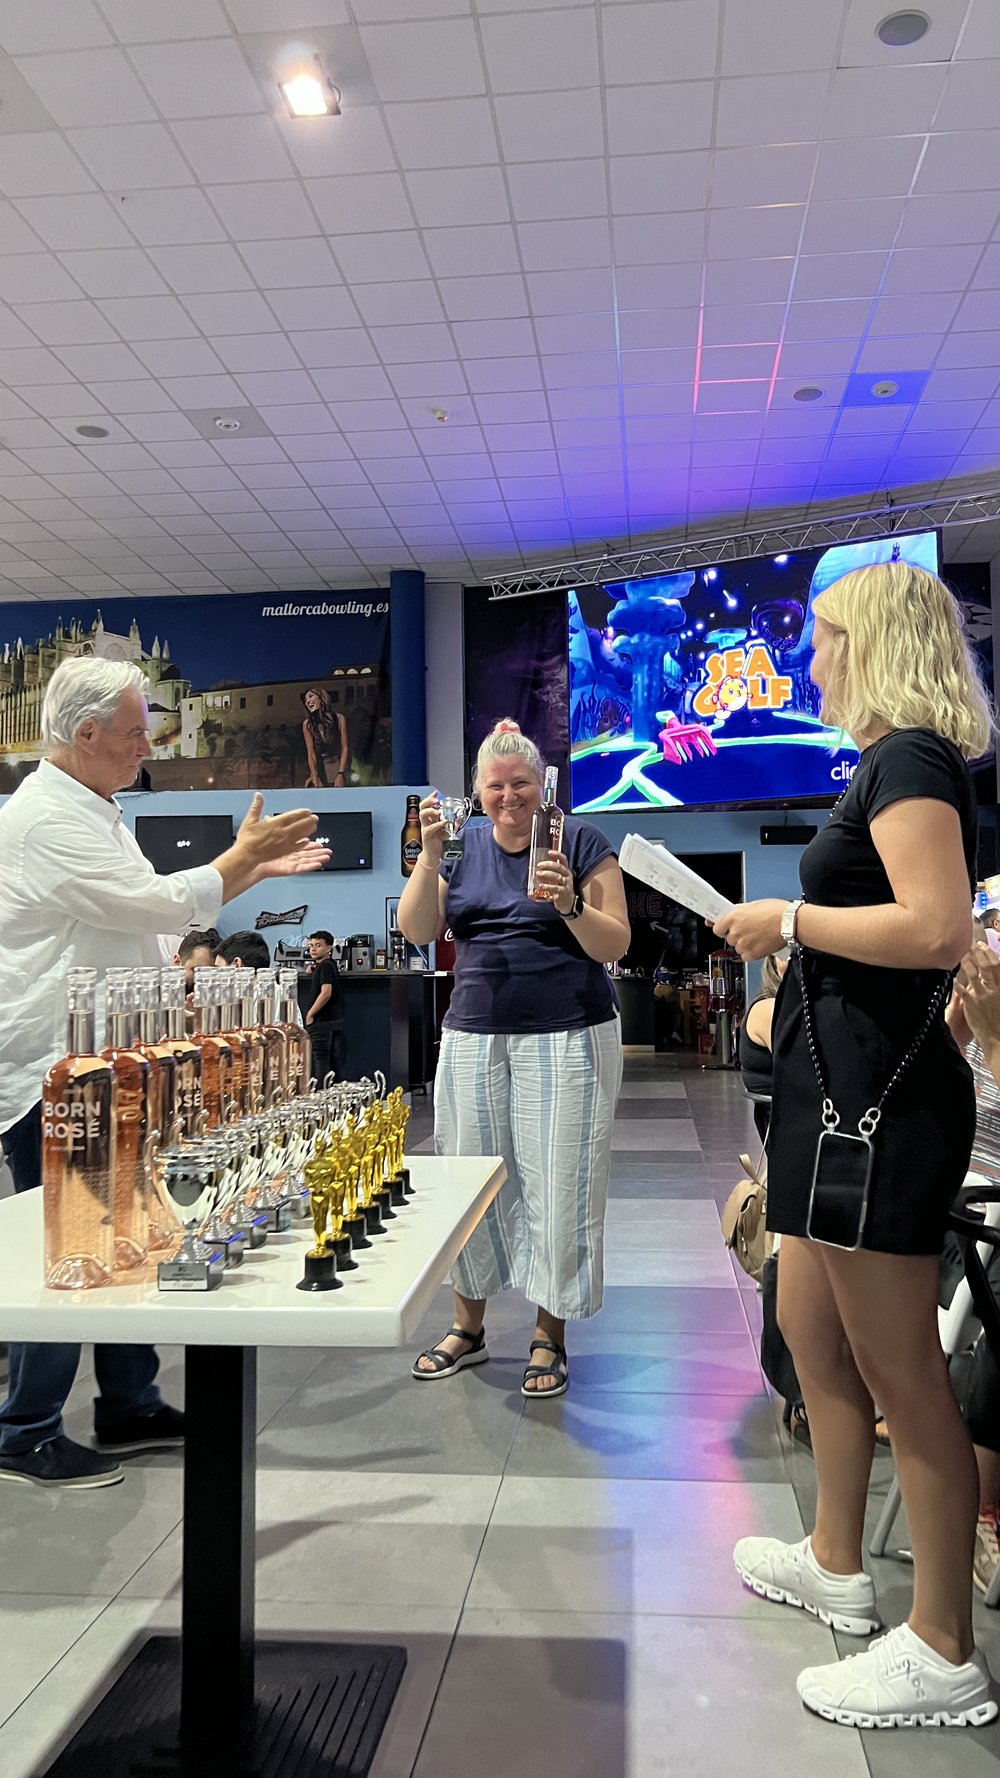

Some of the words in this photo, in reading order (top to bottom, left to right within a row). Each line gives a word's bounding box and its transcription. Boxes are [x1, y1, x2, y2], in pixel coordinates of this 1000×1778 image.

[262, 601, 389, 617] mallorcabowling.es
[706, 646, 777, 685] SEA
[44, 1101, 101, 1118] BORN
[44, 1118, 101, 1139] ROSÉ
